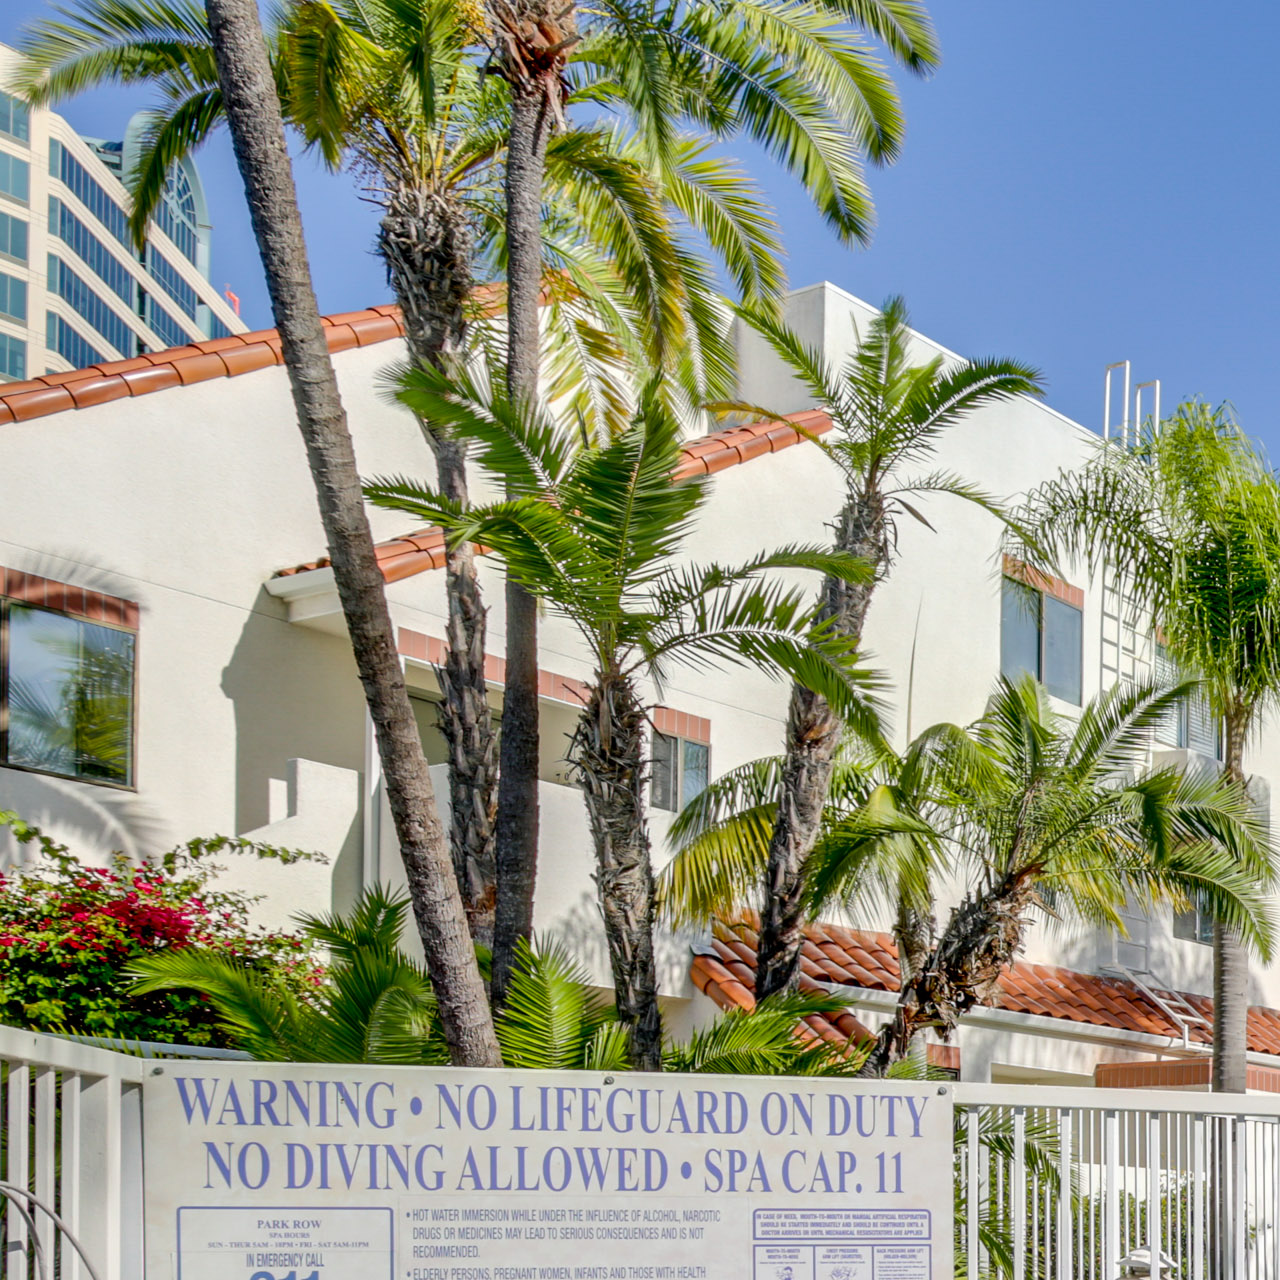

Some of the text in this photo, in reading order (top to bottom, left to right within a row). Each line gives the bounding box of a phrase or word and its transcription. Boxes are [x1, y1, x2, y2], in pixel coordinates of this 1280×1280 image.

[174, 1077, 929, 1137] WARNING NO LIFEGUARD ON DUTY
[202, 1141, 904, 1193] NO DIVING ALLOWED SPA CAP. 11
[413, 1209, 720, 1223] HOT WATER IMMERSION WHILE UNDER THE INFLUENCE OF ALCOHOL, NARCOTIC
[257, 1220, 322, 1229] PARK ROW
[413, 1228, 704, 1239] DRUGS OR MEDICINES MAY LEAD TO SERIOUS CONSEQUENCES AND IS NOT
[413, 1246, 480, 1258] RECOMMENDED.
[247, 1254, 324, 1267] IN EMERGENCY CALL
[414, 1268, 448, 1280] ELDERLY
[494, 1268, 536, 1279] PREGNANT
[539, 1268, 572, 1280] WOMEN,
[575, 1267, 608, 1279] INFANTS
[610, 1267, 626, 1278] AND
[629, 1267, 653, 1278] THOSE
[656, 1267, 675, 1278] WITH
[678, 1266, 706, 1278] HEALTH
